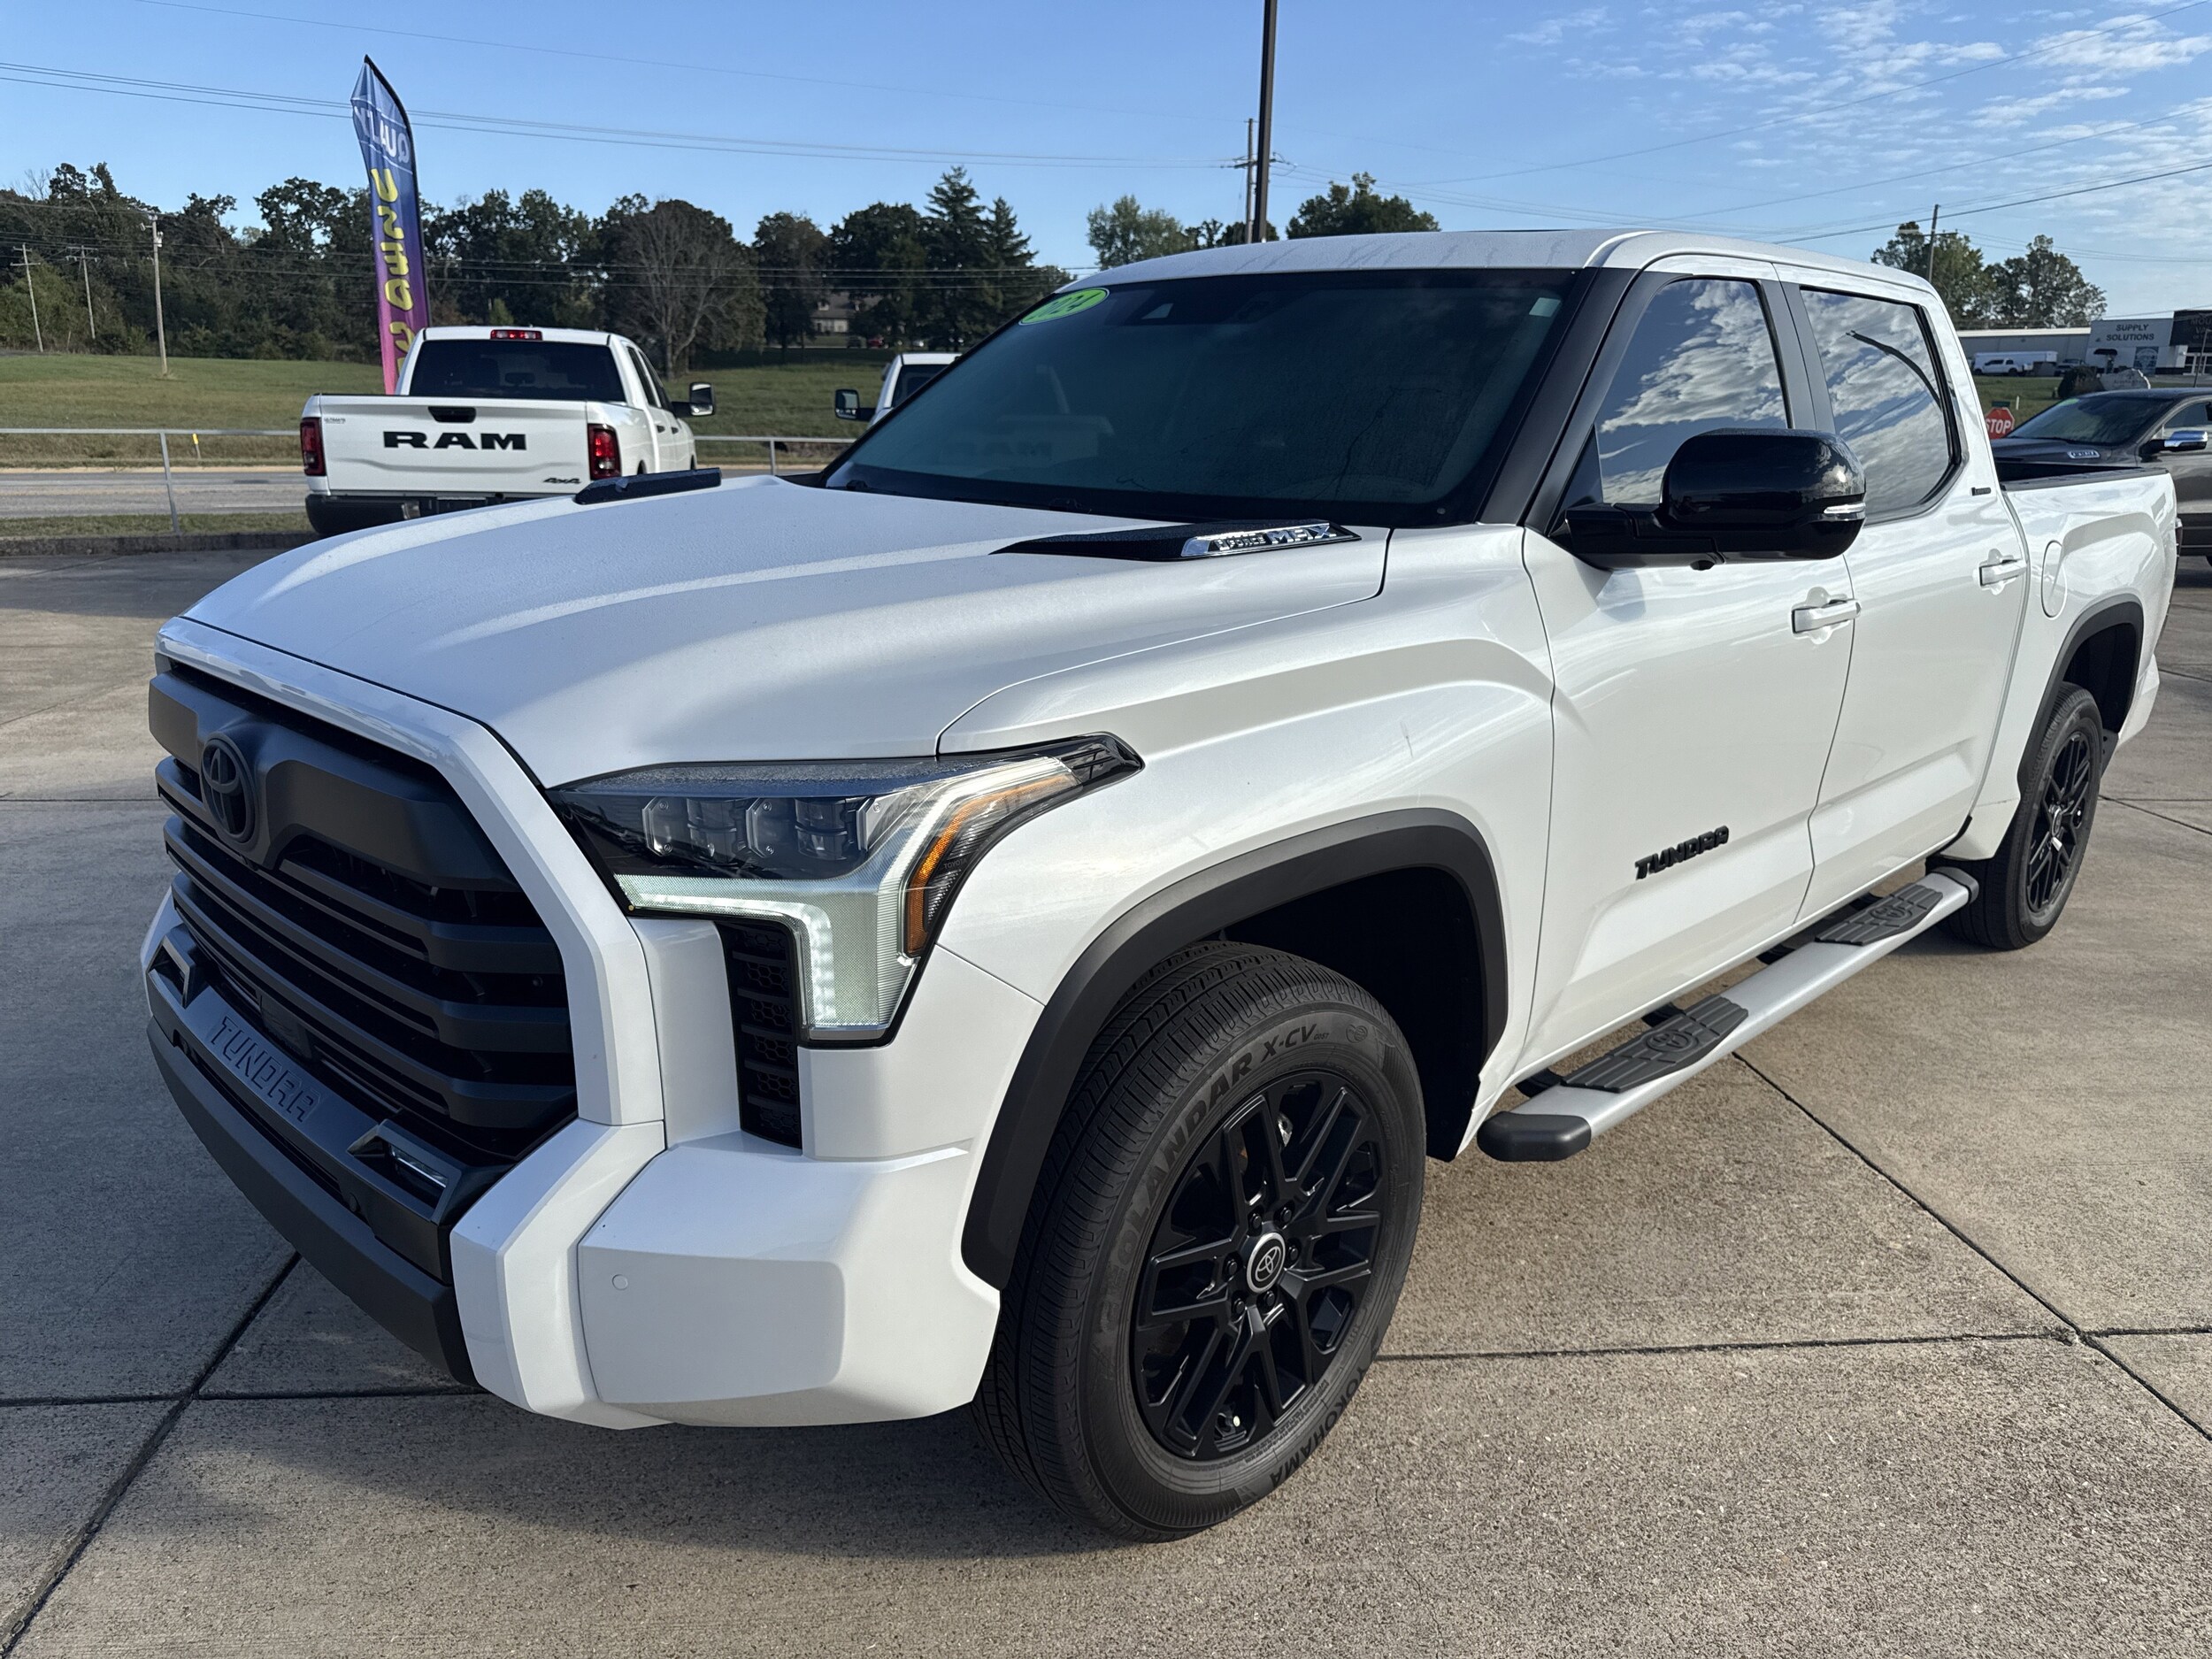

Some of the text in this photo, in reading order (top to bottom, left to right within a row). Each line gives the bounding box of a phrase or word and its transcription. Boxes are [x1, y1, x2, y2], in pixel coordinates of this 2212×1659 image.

[2106, 333, 2154, 342] SOLUTIONS
[1985, 419, 2011, 434] STOP
[383, 431, 526, 451] RAM
[1265, 523, 1337, 545] MAX
[943, 857, 968, 870] TOYOTA
[1635, 825, 1729, 880] TUNDRA
[1262, 1024, 1317, 1062] X-CV
[211, 1016, 321, 1123] TUNDRA
[1269, 1366, 1369, 1488] YOKOHAMA
